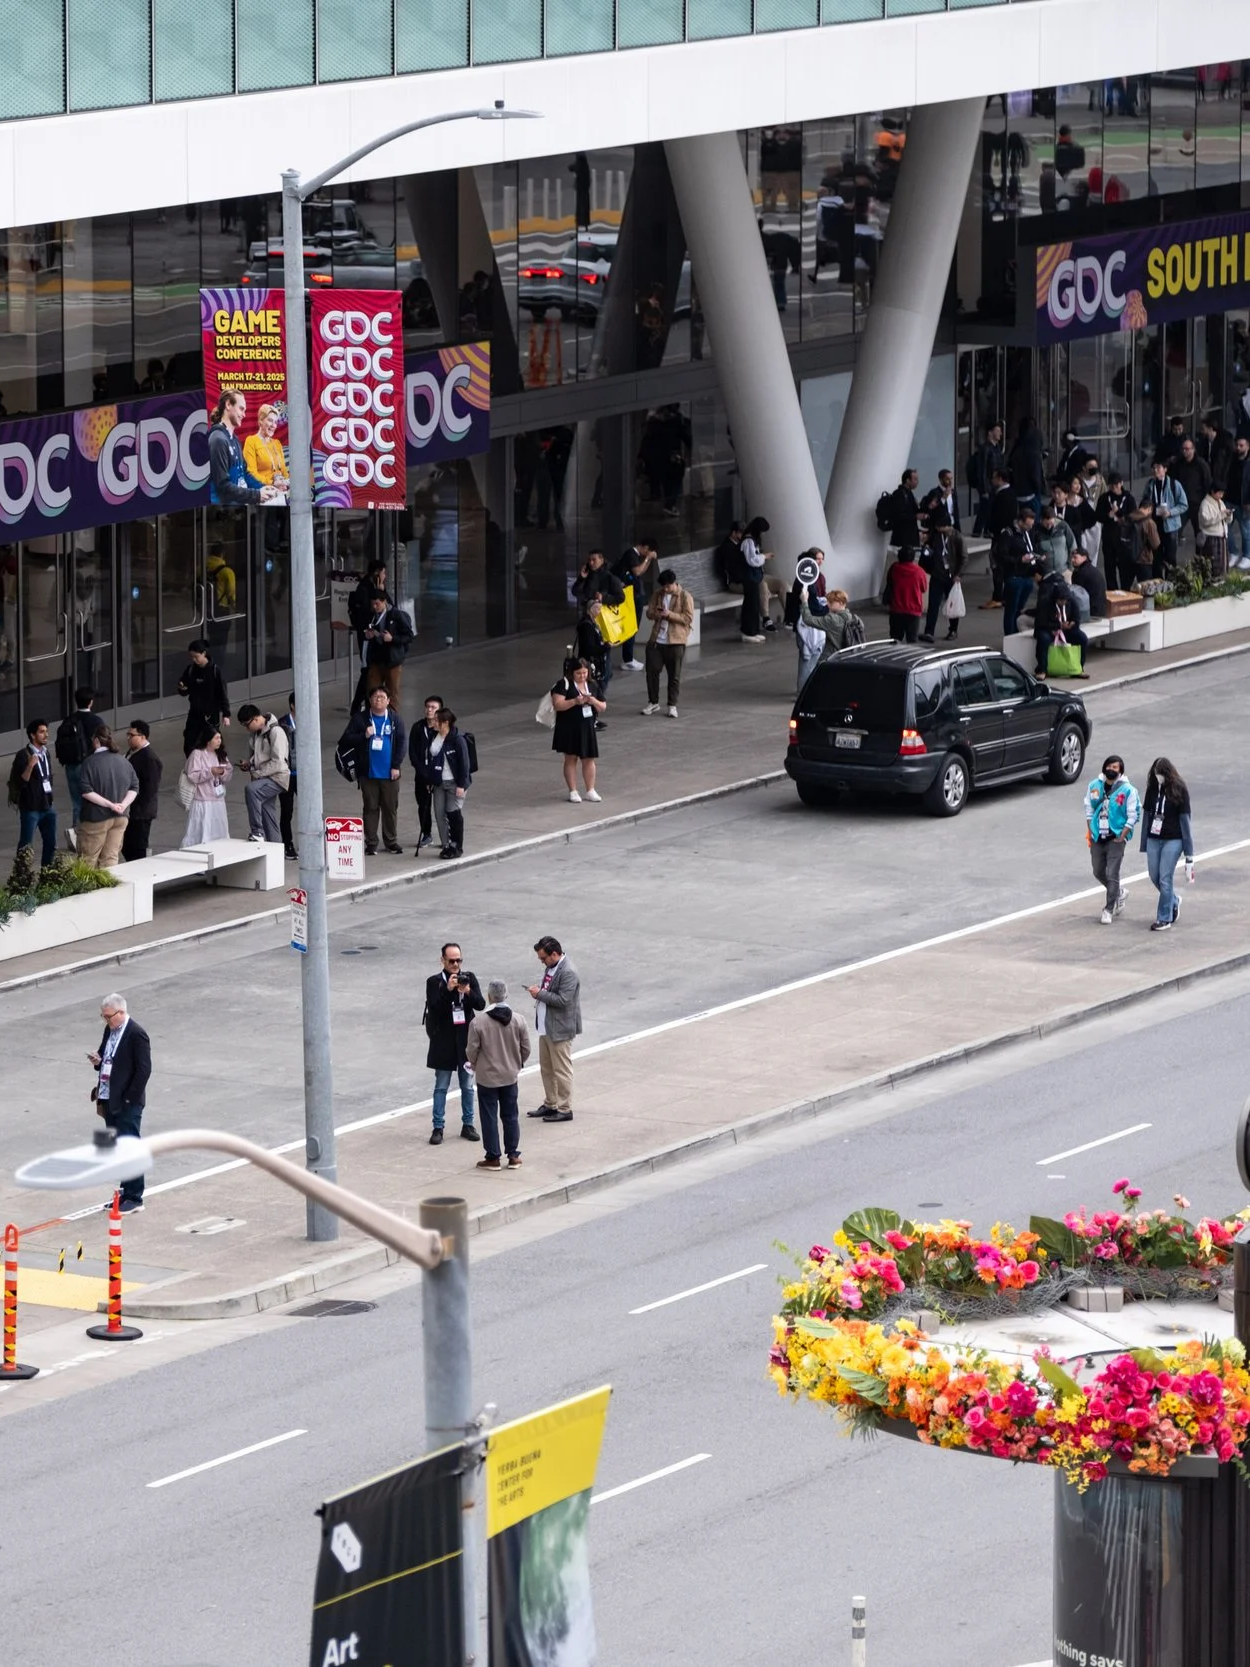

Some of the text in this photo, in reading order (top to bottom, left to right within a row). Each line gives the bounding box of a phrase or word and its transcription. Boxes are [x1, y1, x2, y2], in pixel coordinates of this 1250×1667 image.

[1047, 250, 1126, 328] GDC
[1146, 234, 1238, 299] SOUTH
[214, 309, 281, 333] GAME
[320, 310, 393, 346] GDC
[215, 335, 281, 347] DEVELOPERS
[216, 348, 282, 360] CONFERENCE
[217, 372, 285, 382] MARCH 17-21, 2025
[320, 346, 394, 381] GDC
[321, 382, 395, 417] GDC
[97, 409, 211, 505] GDC
[404, 363, 472, 449] DC
[321, 417, 396, 452] GDC
[323, 452, 396, 488] GDC
[327, 832, 339, 841] NO
[338, 845, 352, 854] ANY
[338, 857, 353, 867] TIME
[323, 1631, 359, 1667] Art
